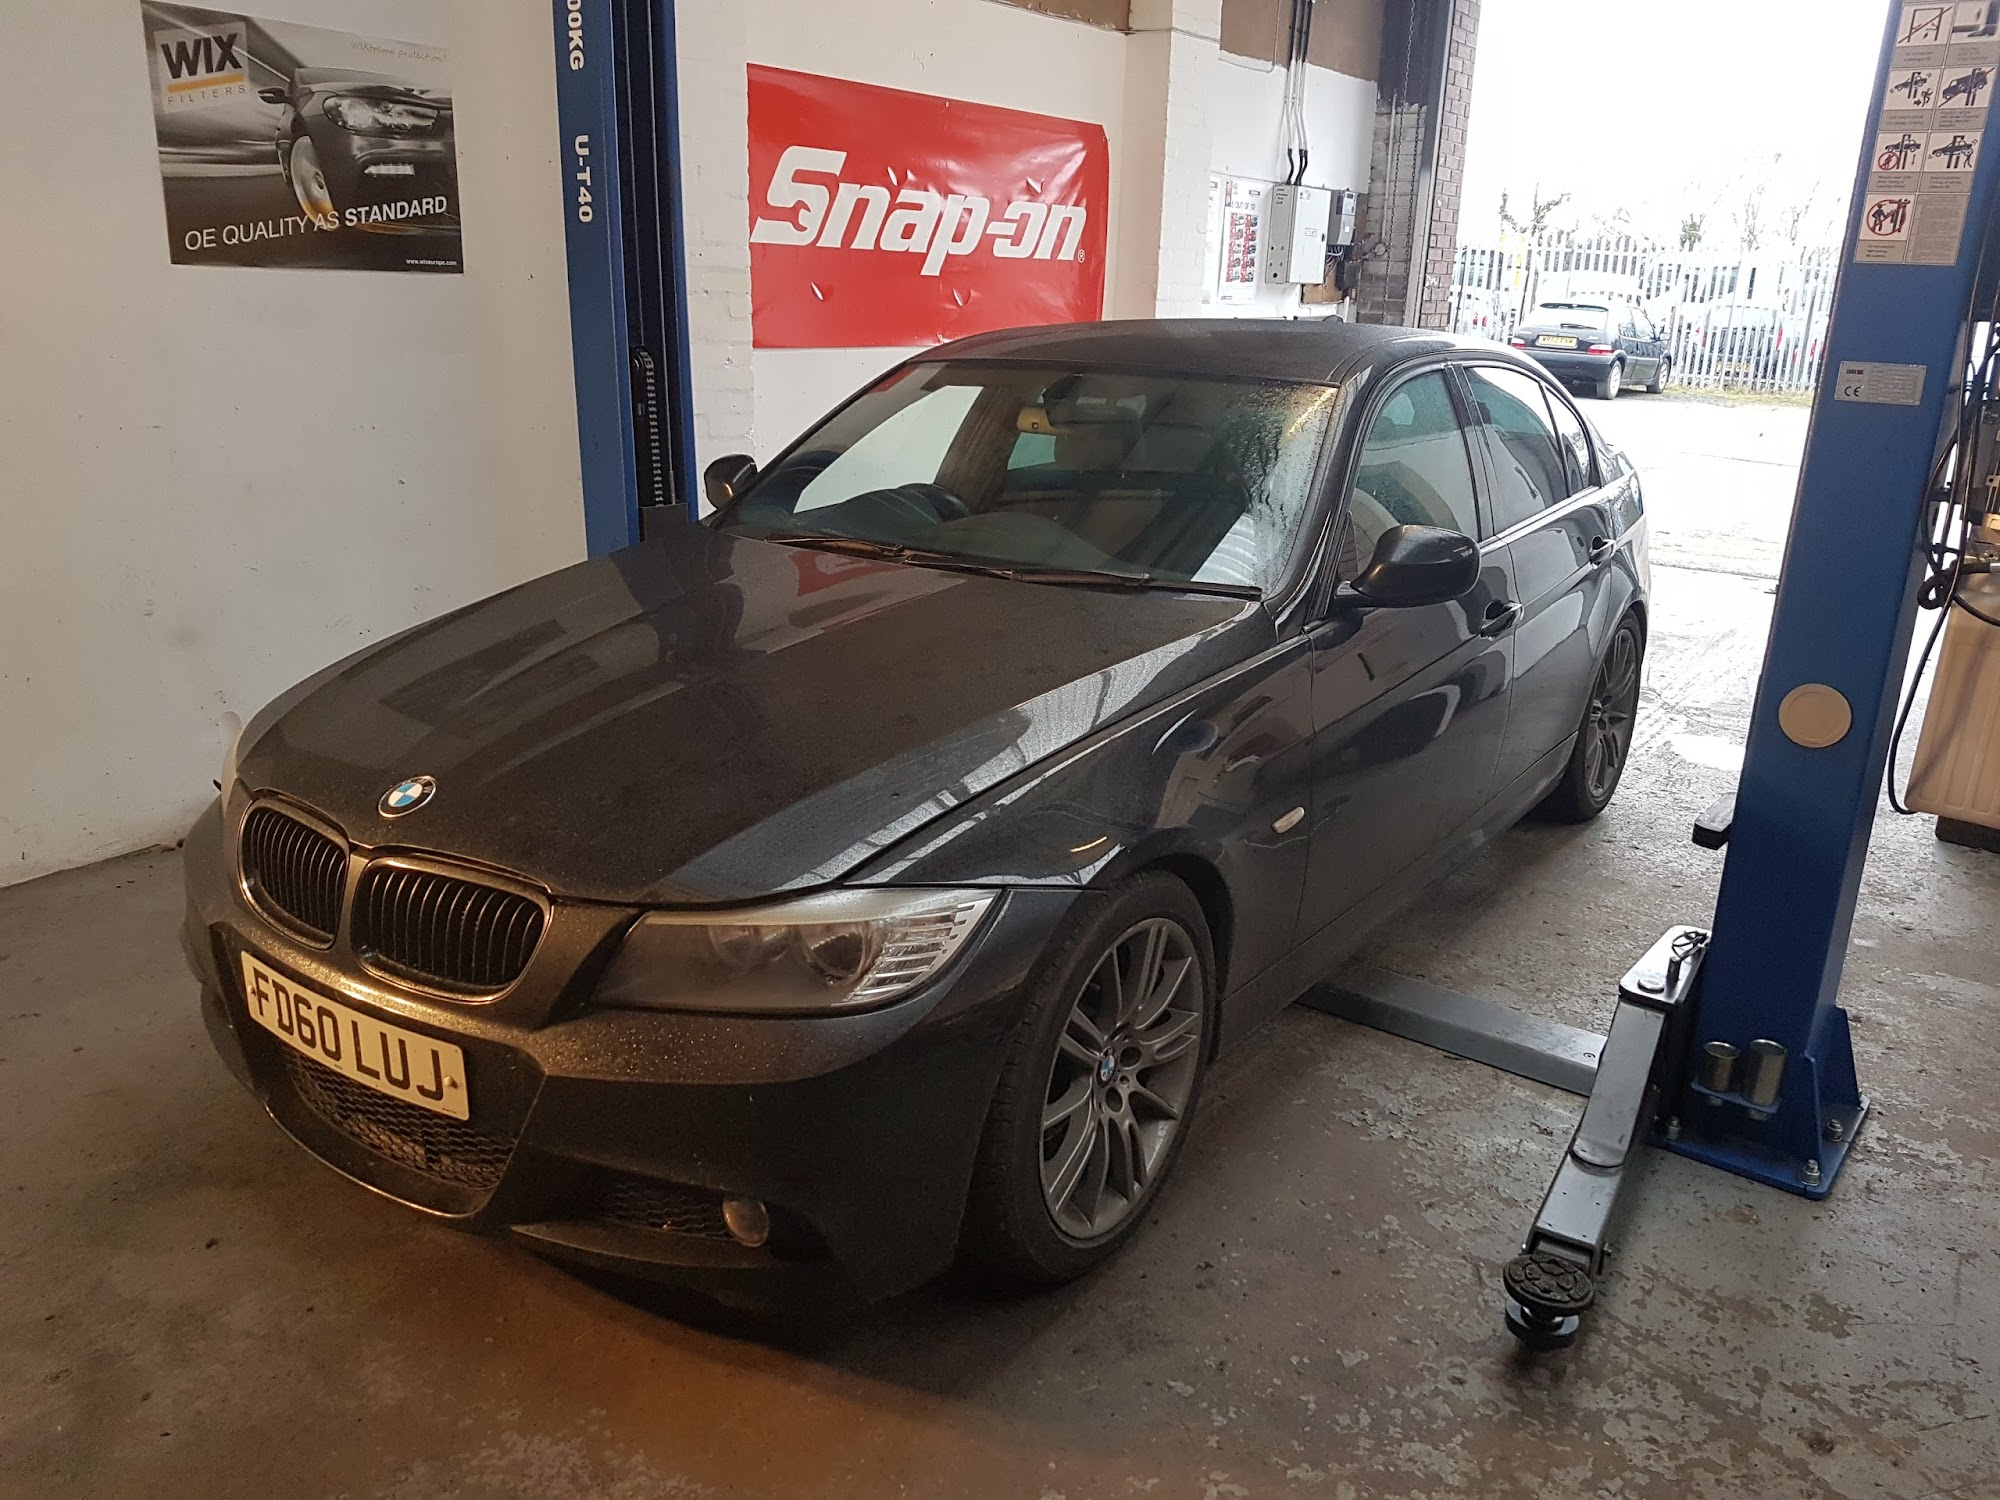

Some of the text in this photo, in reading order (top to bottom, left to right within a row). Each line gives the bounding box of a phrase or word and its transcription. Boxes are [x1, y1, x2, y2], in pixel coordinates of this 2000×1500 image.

[161, 33, 243, 79] WIX
[168, 85, 246, 105] FILTERS
[575, 135, 593, 222] U-T40
[750, 145, 1087, 276] Snap-on
[184, 196, 448, 251] OE QUALITY AS STANDARD
[253, 966, 443, 1101] FD60 LUJ
